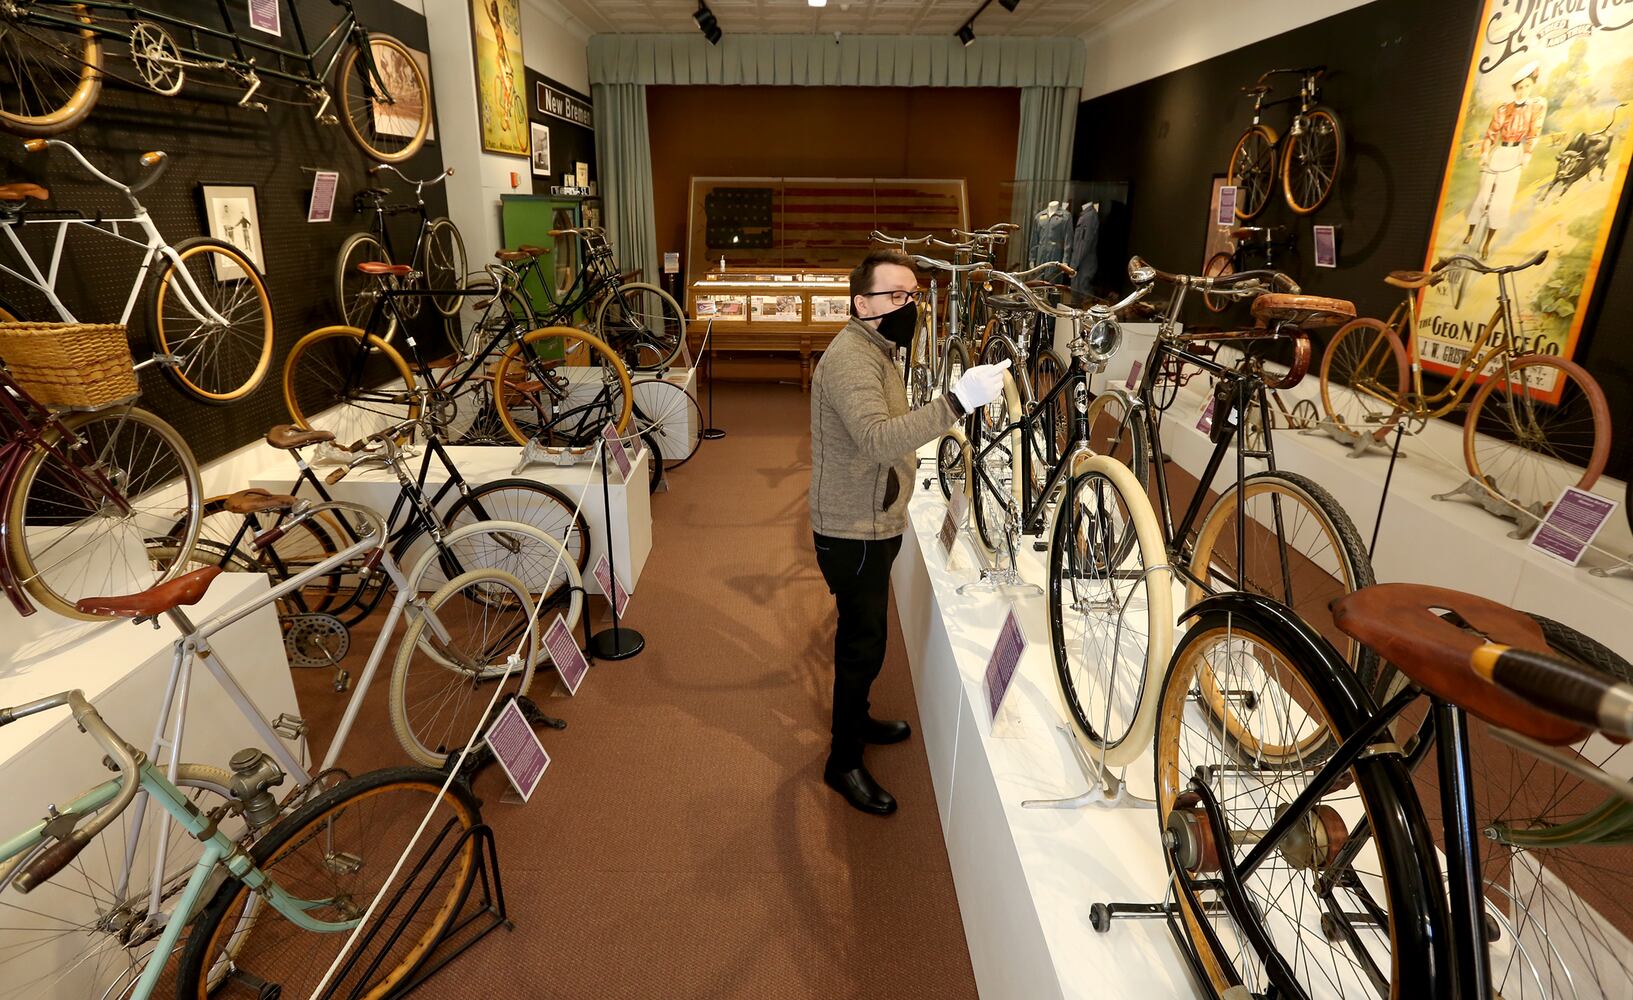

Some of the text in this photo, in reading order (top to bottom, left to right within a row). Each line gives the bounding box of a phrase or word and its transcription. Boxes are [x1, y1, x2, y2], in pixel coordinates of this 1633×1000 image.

[545, 88, 563, 115] New
[1460, 320, 1473, 343] N.
[1474, 323, 1532, 353] PIECE
